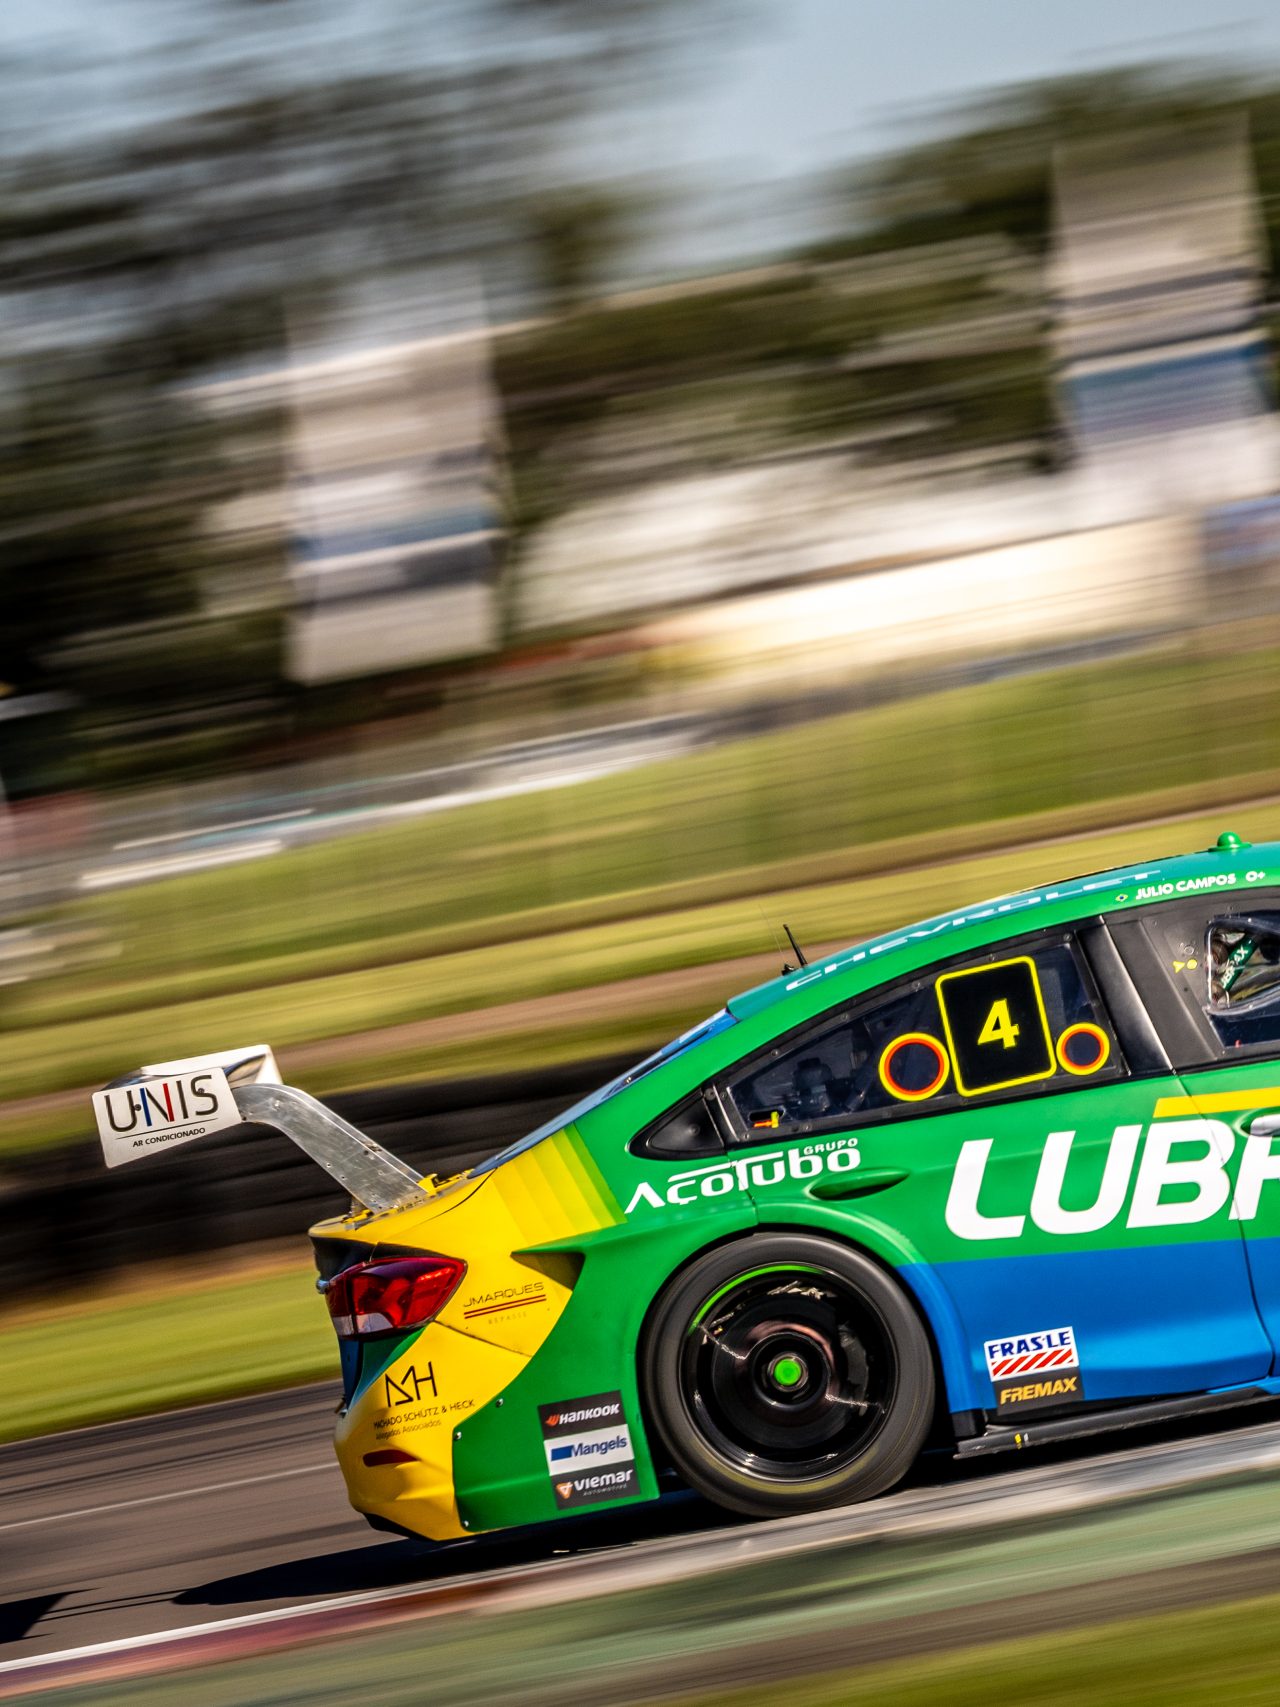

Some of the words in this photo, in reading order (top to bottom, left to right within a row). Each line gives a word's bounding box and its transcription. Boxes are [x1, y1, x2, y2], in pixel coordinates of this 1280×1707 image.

[1135, 883, 1174, 900] JULIO
[1176, 873, 1237, 892] CAMPOS
[1245, 870, 1266, 882] O+
[977, 998, 1020, 1050] 4
[104, 1074, 219, 1132] UNIS
[132, 1138, 144, 1148] AR
[145, 1127, 206, 1145] CONDICIONADO
[803, 1138, 858, 1156] GRUPO
[463, 1282, 545, 1307] JMARQUES
[1000, 1376, 1078, 1405] FREMAX
[441, 1406, 447, 1414] &
[450, 1399, 476, 1411] HECK
[572, 1435, 627, 1457] Mangels
